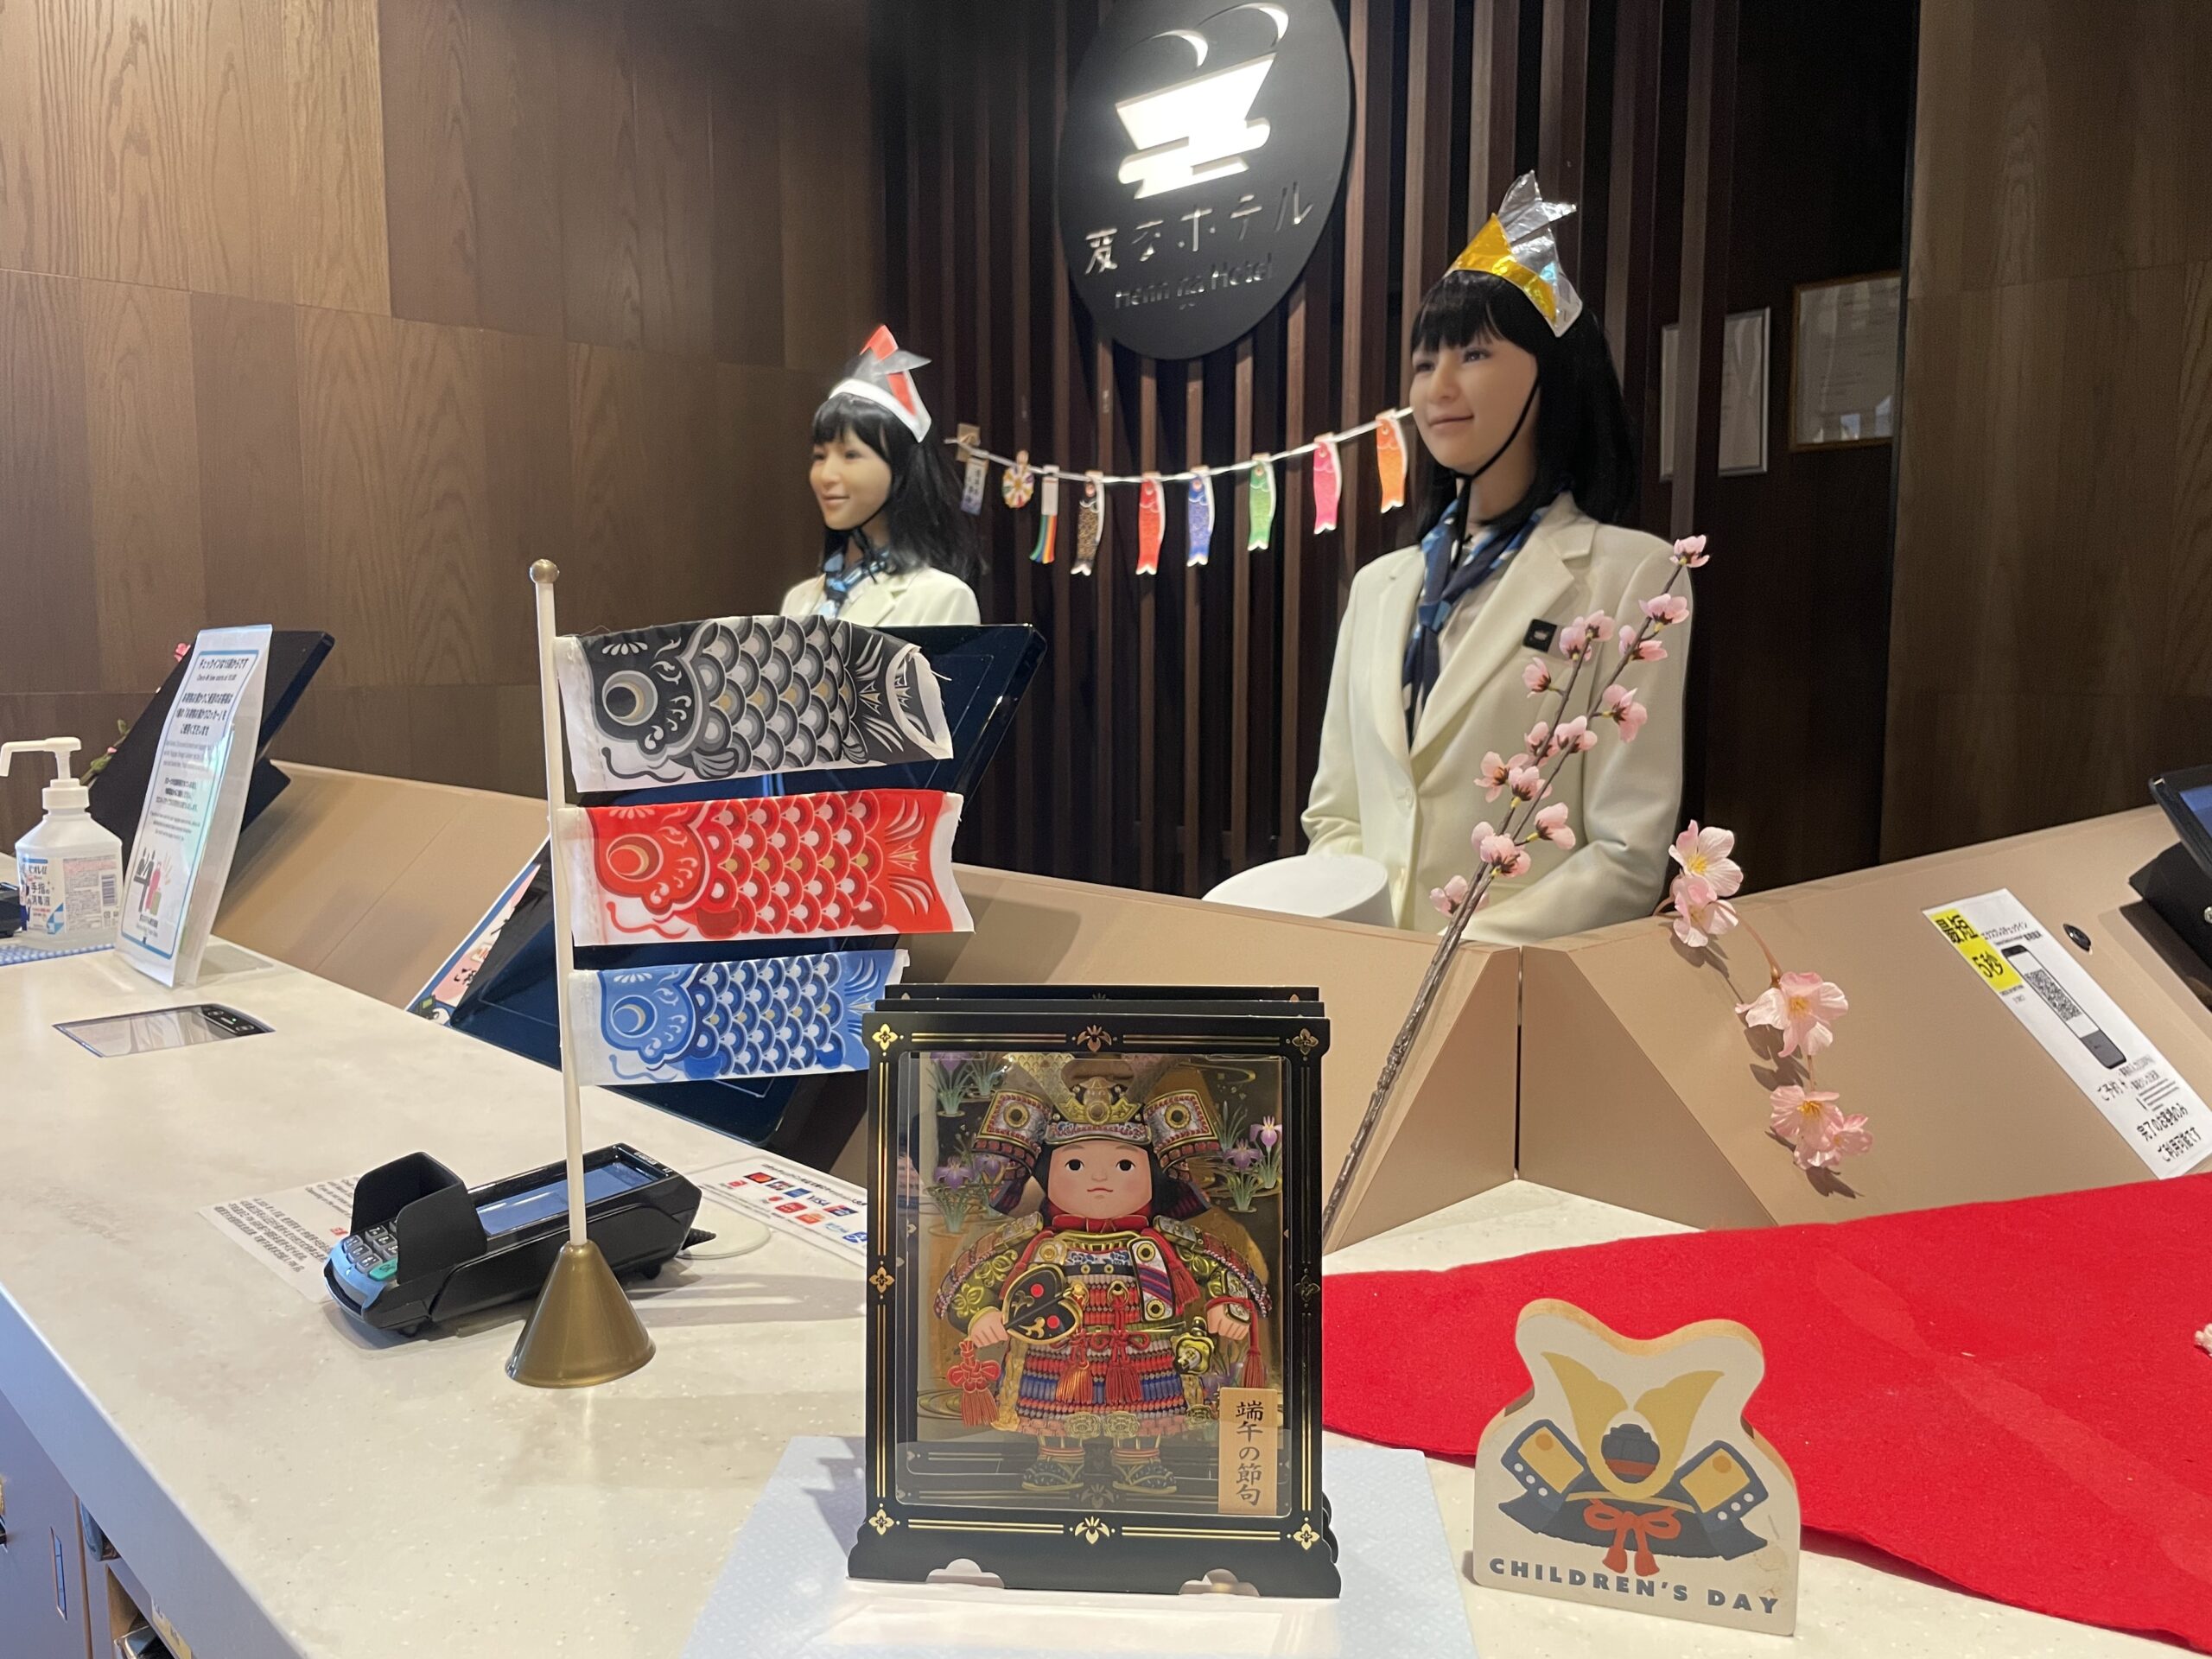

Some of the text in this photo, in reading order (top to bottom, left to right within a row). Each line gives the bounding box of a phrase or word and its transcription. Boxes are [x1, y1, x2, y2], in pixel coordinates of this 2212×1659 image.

[1115, 282, 1169, 309] Henn
[1211, 252, 1273, 289] Hotel
[1936, 915, 1979, 944] 最短
[1972, 952, 2004, 978] 5秒
[2097, 1080, 2122, 1101] ご予約
[2137, 1103, 2189, 1141] 完了のお客様のみ
[2158, 1127, 2202, 1162] ご利用可能です
[1236, 1400, 1264, 1506] 端午の節句
[1490, 1558, 1779, 1614] CHILDREN'S DAY
